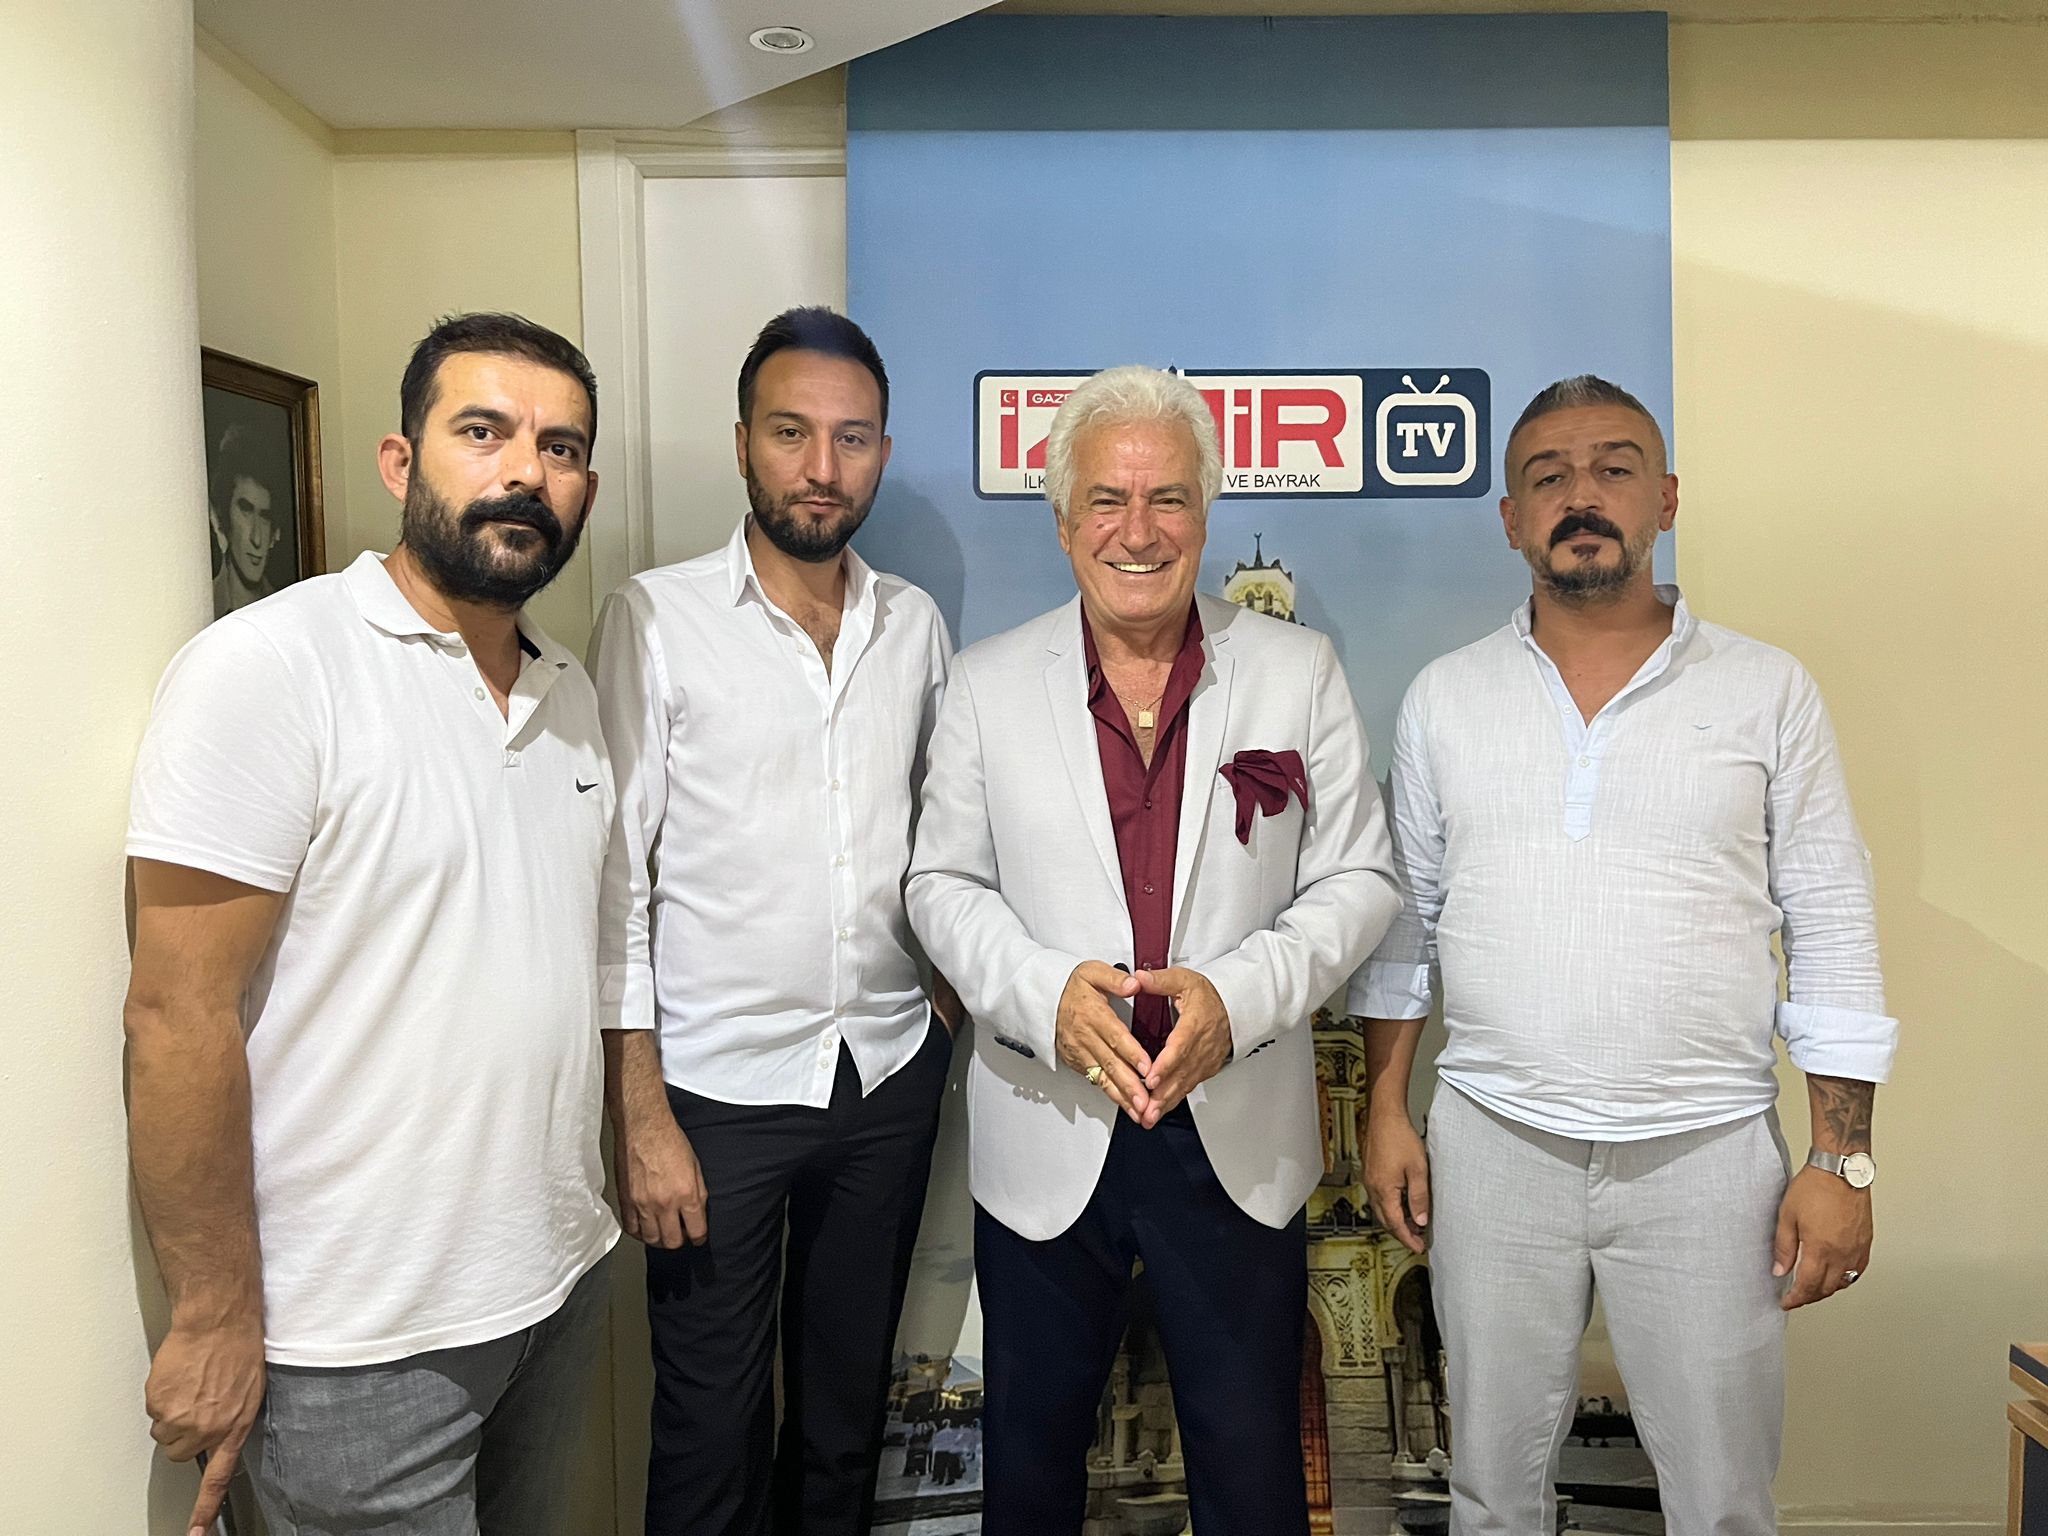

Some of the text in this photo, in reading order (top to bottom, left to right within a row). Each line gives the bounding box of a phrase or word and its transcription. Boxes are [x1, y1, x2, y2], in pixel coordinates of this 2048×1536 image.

[1396, 422, 1456, 457] TV
[1226, 474, 1249, 488] VE
[1254, 473, 1321, 488] BAYRAK
